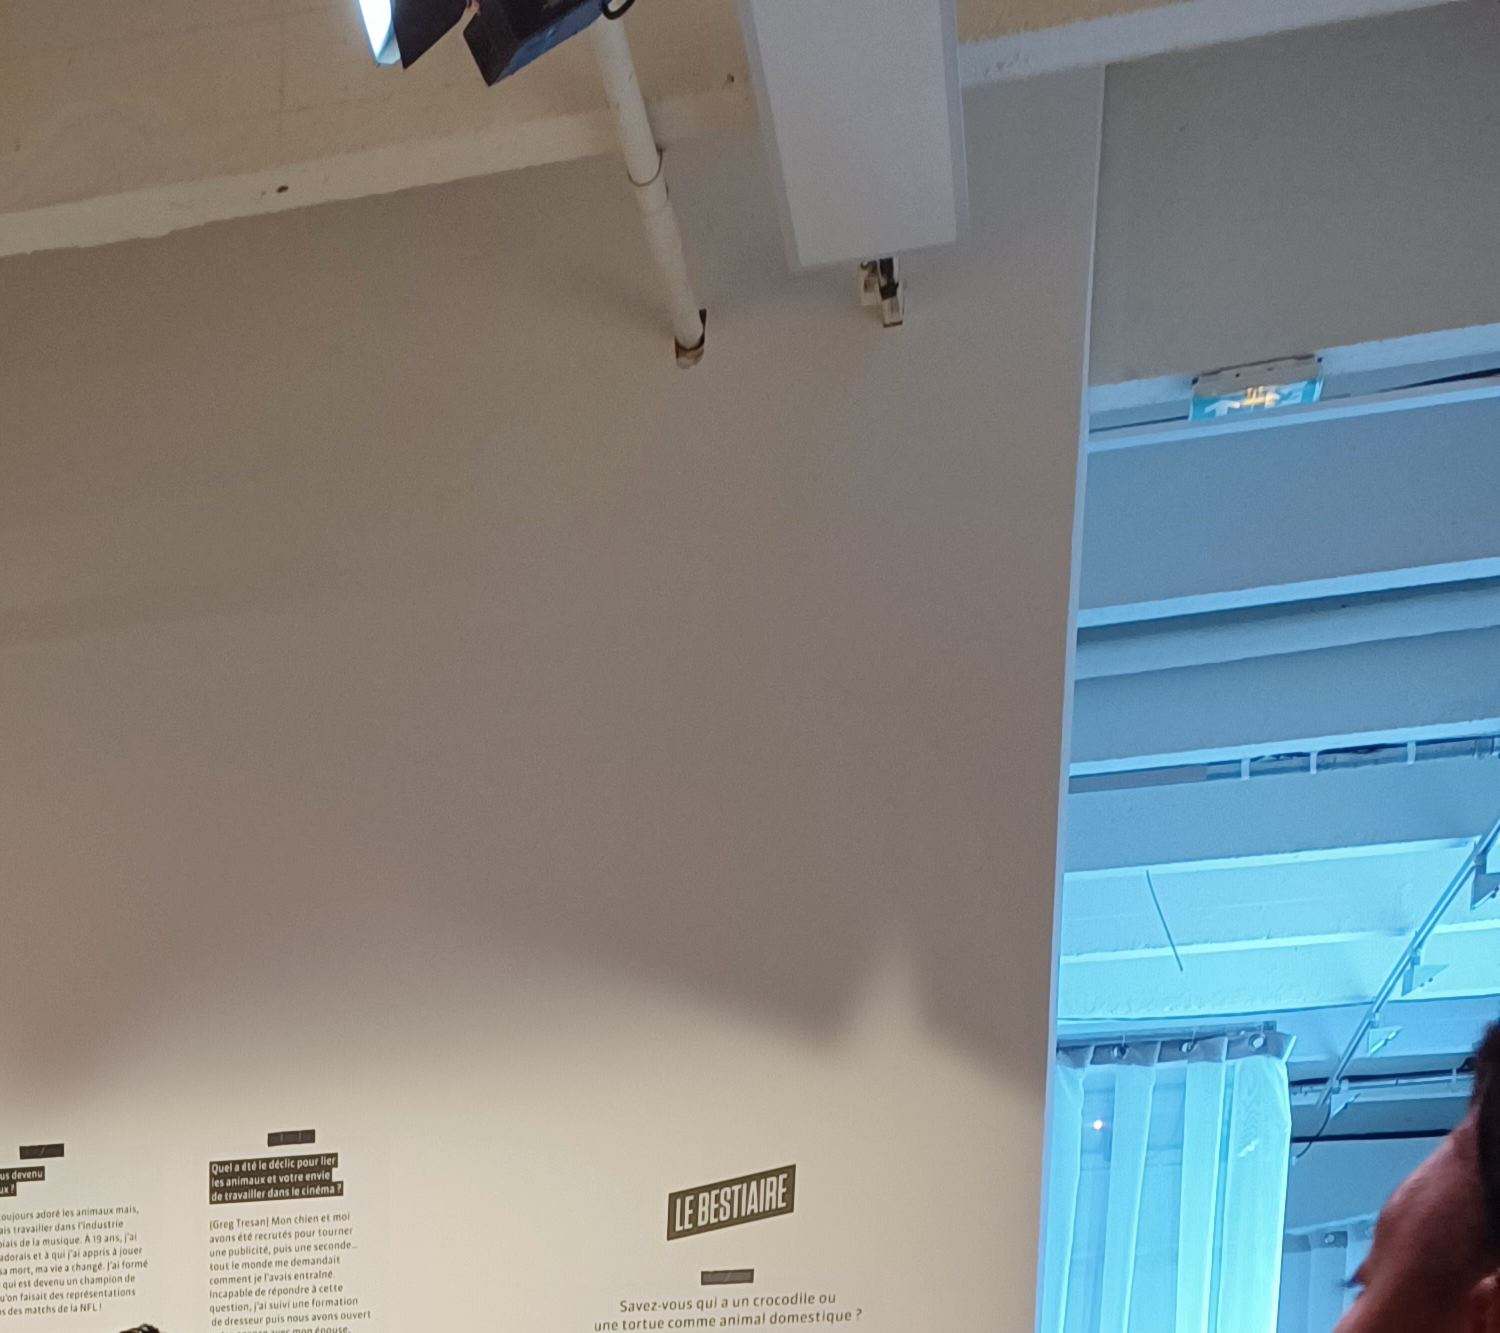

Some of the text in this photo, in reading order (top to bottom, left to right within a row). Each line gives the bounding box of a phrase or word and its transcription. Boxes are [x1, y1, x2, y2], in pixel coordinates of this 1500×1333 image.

[211, 1163, 233, 1175] Quel
[241, 1161, 257, 1171] été
[268, 1158, 295, 1169] déclic
[296, 1158, 319, 1169] pour
[321, 1156, 336, 1166] lier
[12, 1170, 43, 1180] devenu
[225, 1176, 265, 1187] animaux
[278, 1173, 304, 1183] votre
[305, 1171, 330, 1181] envie
[224, 1188, 265, 1201] travailler
[267, 1187, 290, 1198] dans
[301, 1185, 335, 1196] cinéma
[675, 1173, 787, 1232] LE BESTIAIRE
[35, 1210, 60, 1219] adoré
[76, 1208, 113, 1216] animaux
[115, 1206, 139, 1215] mais,
[271, 1216, 292, 1225] Mon
[294, 1214, 319, 1224] chien
[332, 1213, 350, 1222] moi
[13, 1224, 52, 1234] travailler
[54, 1223, 76, 1232] dans
[77, 1220, 123, 1230] l'industrie
[209, 1228, 353, 1243] avons été recrutés pour tourner
[619, 1299, 692, 1312] Savez-vous
[696, 1299, 717, 1311] qui
[732, 1298, 749, 1308] un
[752, 1293, 815, 1307] crocodile
[818, 1294, 836, 1304] ou
[594, 1322, 618, 1331] une
[622, 1319, 664, 1330] tortue
[667, 1318, 716, 1328] comme
[719, 1314, 766, 1326] animal
[769, 1311, 852, 1325] domestique
